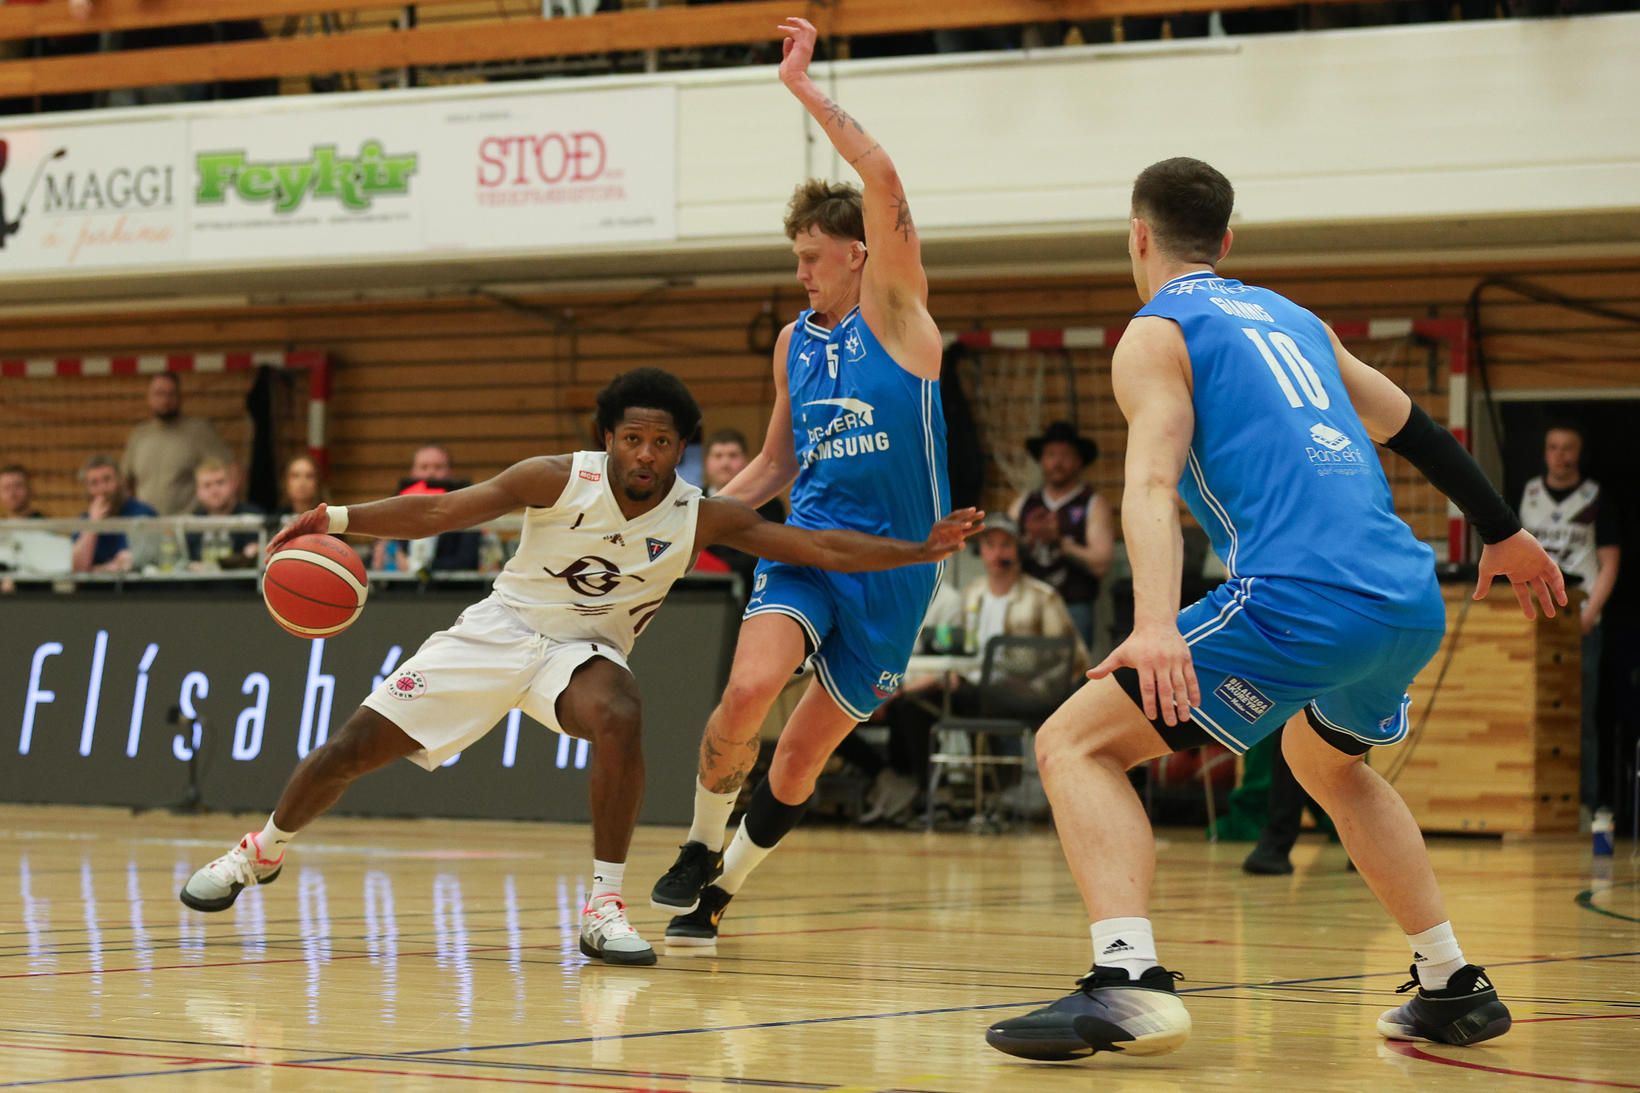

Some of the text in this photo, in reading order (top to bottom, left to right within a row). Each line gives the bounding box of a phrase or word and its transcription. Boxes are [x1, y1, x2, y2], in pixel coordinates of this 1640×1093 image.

[43, 165, 174, 212] MAGGI
[196, 140, 418, 214] Feykir
[825, 343, 840, 380] 5
[1241, 327, 1330, 411] 10
